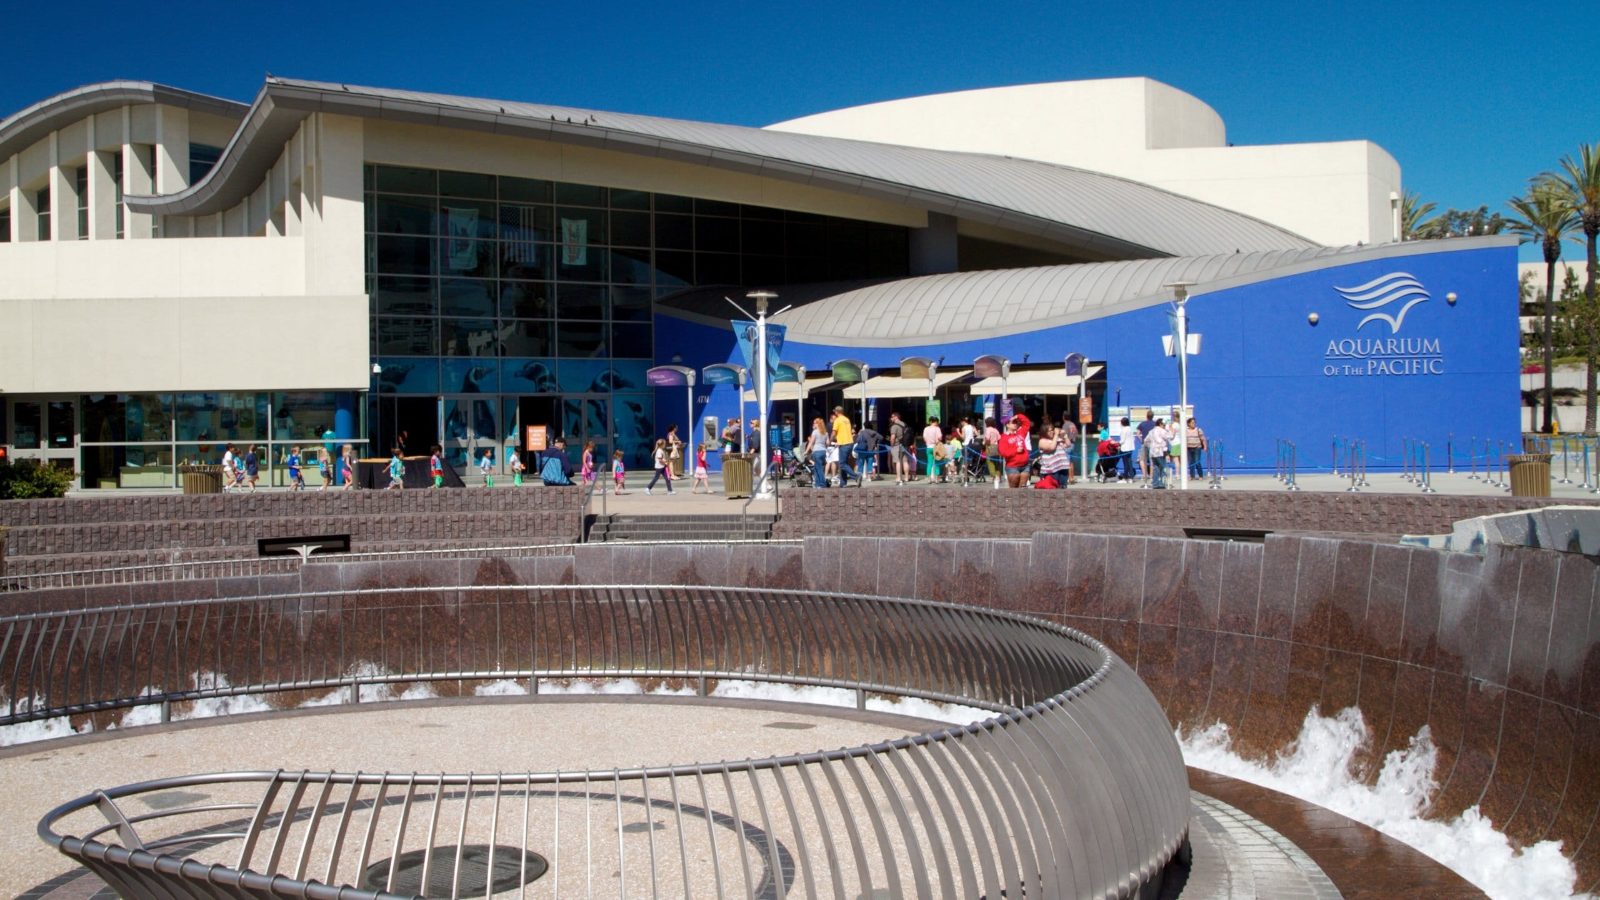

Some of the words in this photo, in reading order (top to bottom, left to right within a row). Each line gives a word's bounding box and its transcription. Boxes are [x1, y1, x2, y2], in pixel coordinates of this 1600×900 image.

[1325, 338, 1441, 358] AQUARIUM
[1367, 359, 1444, 375] PACIFIC
[696, 395, 710, 404] ATM
